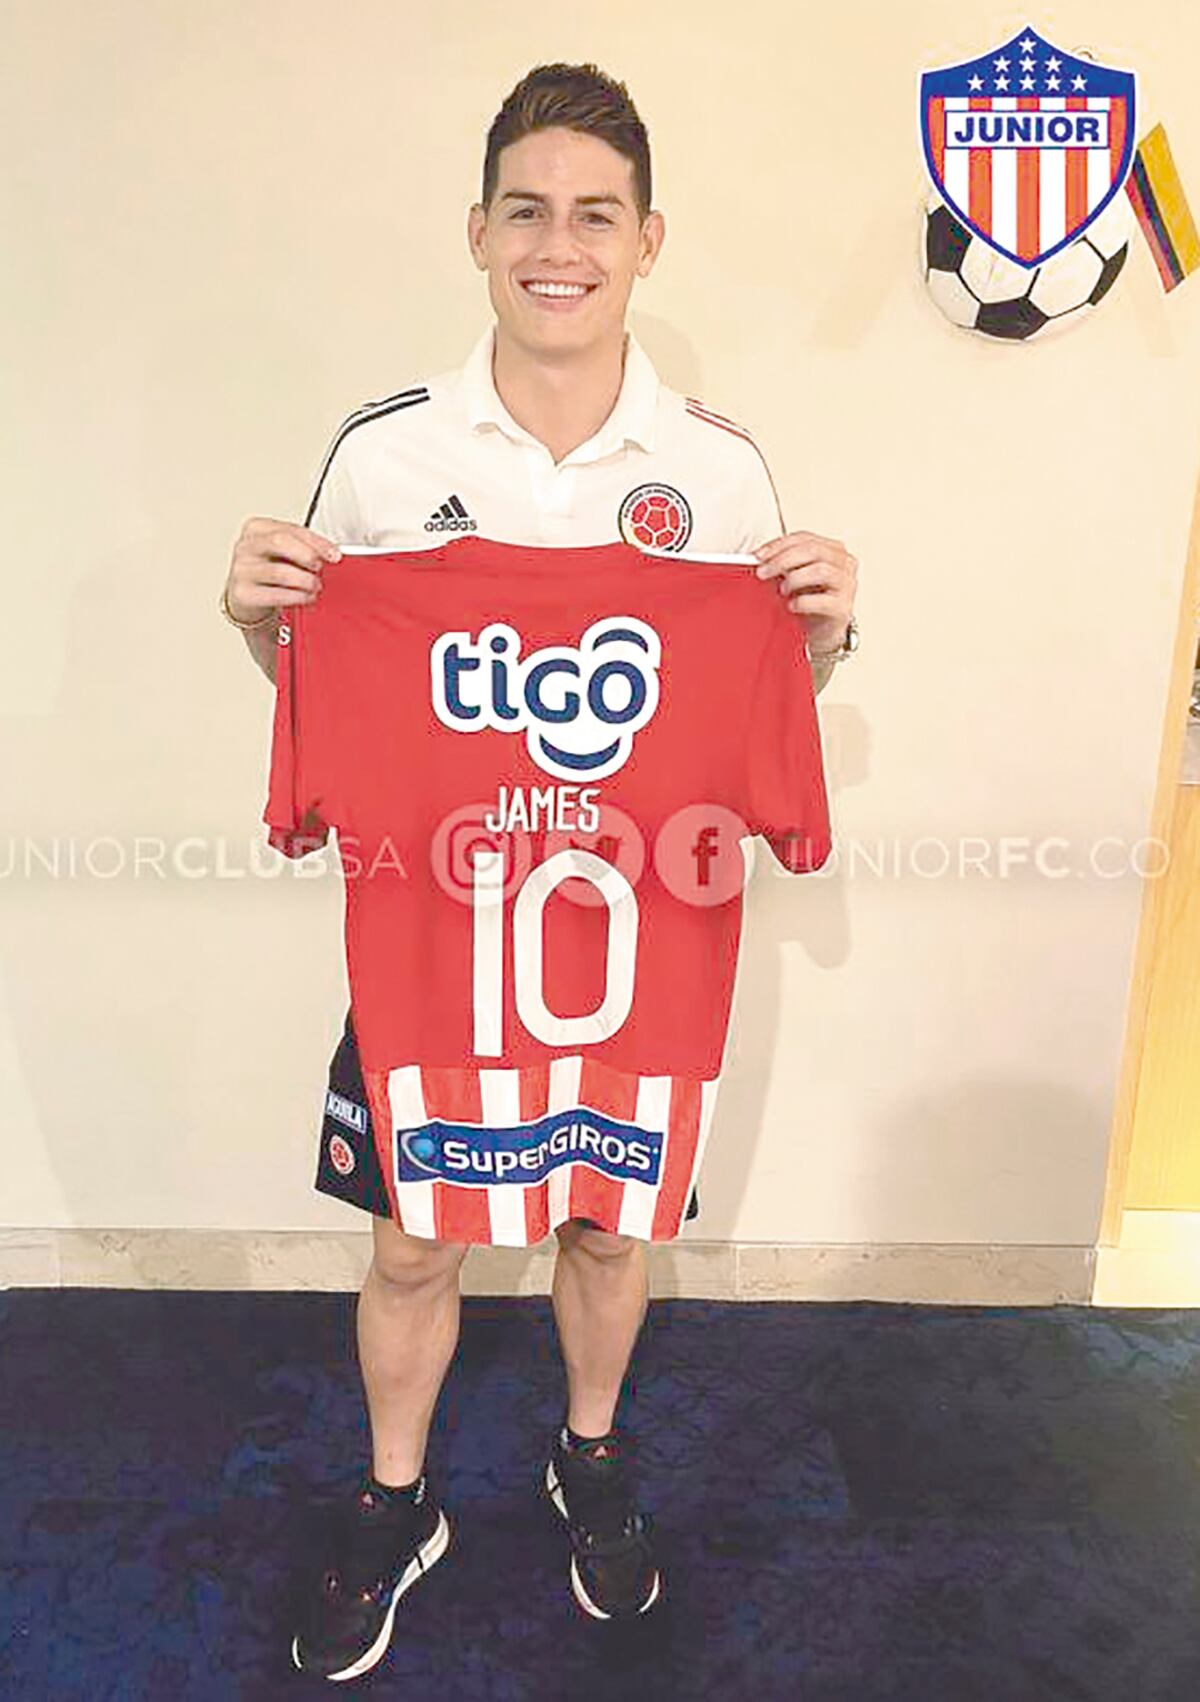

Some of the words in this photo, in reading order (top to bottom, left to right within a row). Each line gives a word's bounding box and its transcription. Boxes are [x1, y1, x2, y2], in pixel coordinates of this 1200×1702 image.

[423, 517, 478, 532] adidas
[485, 785, 601, 833] JAMES
[472, 849, 639, 1057] 10
